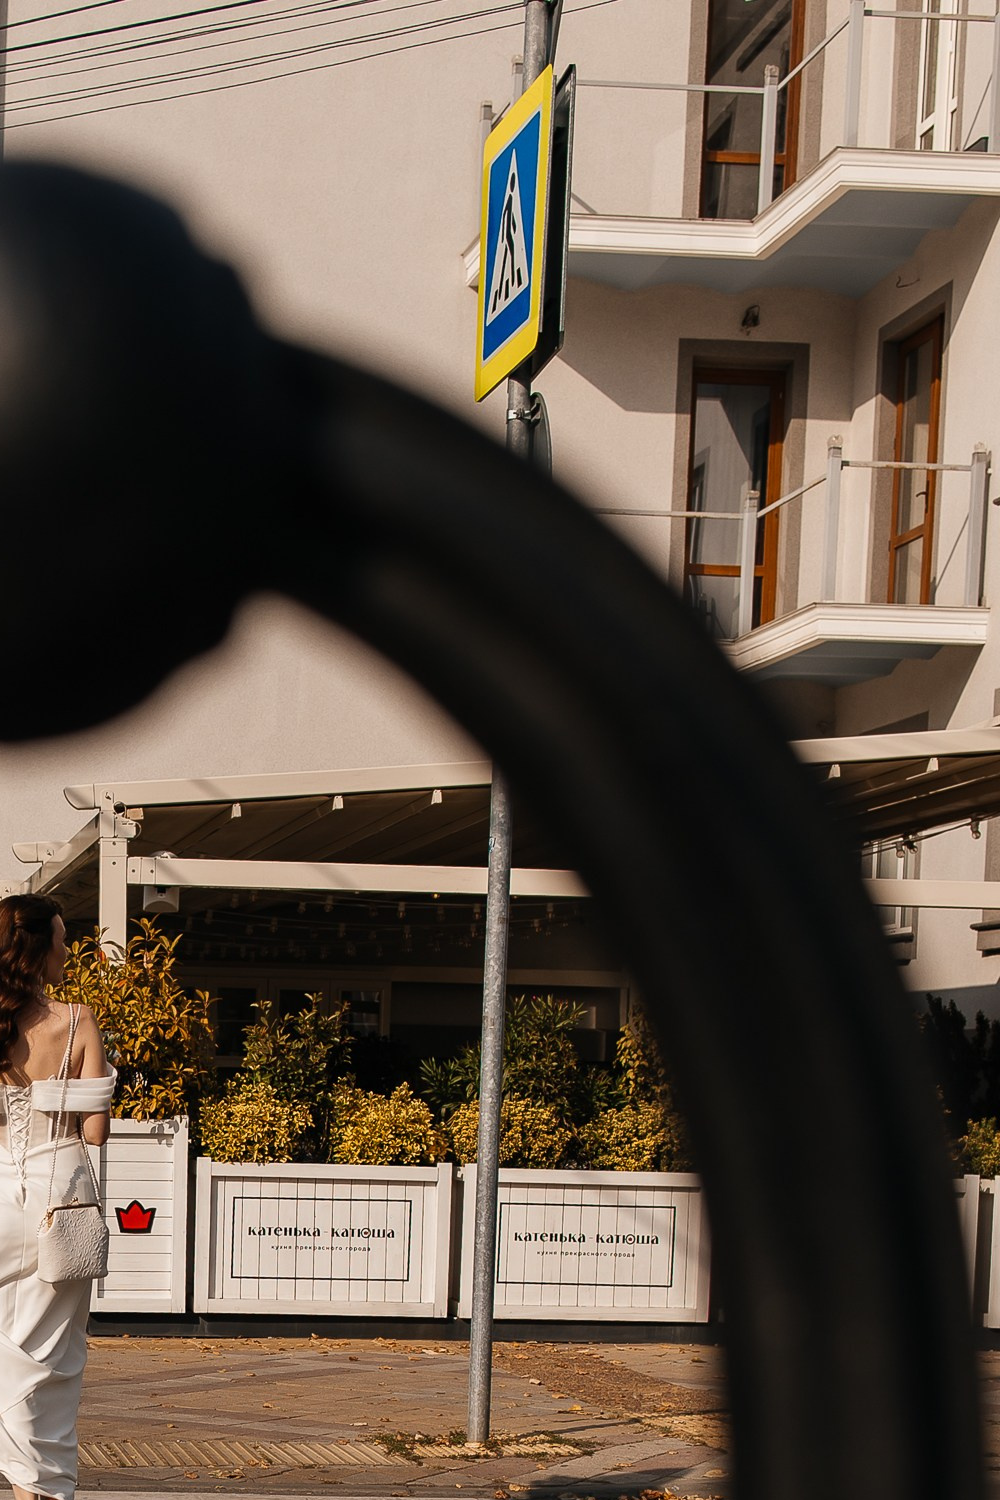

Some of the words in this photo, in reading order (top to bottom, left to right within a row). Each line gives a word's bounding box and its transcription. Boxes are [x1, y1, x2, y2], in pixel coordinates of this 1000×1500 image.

[248, 1226, 321, 1237] катенька
[330, 1227, 395, 1239] катюша
[514, 1232, 586, 1243] катенька
[595, 1233, 659, 1245] катюша
